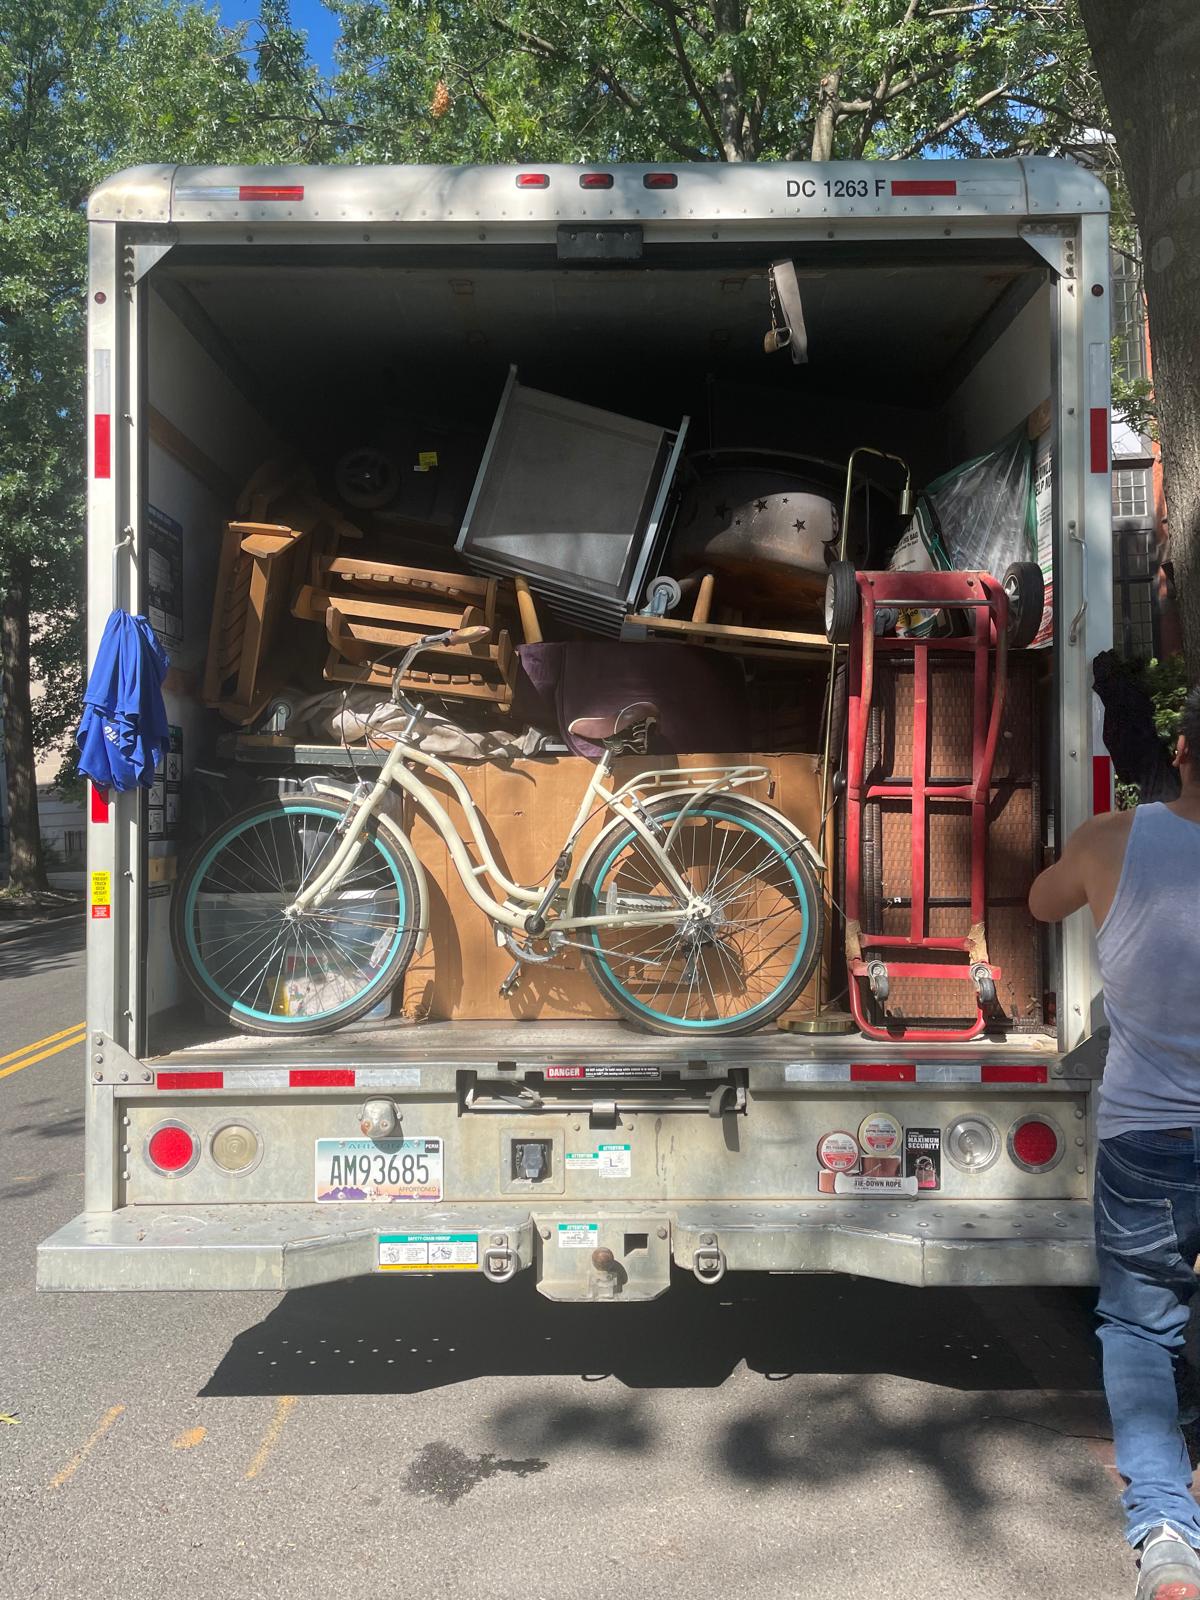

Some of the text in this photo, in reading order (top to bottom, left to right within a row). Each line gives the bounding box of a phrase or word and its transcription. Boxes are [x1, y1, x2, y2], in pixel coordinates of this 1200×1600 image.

[787, 180, 886, 197] DC 1263 F
[548, 1067, 580, 1077] DANGER
[330, 1154, 429, 1186] AM93685
[855, 1180, 883, 1188] TIE-DOWN
